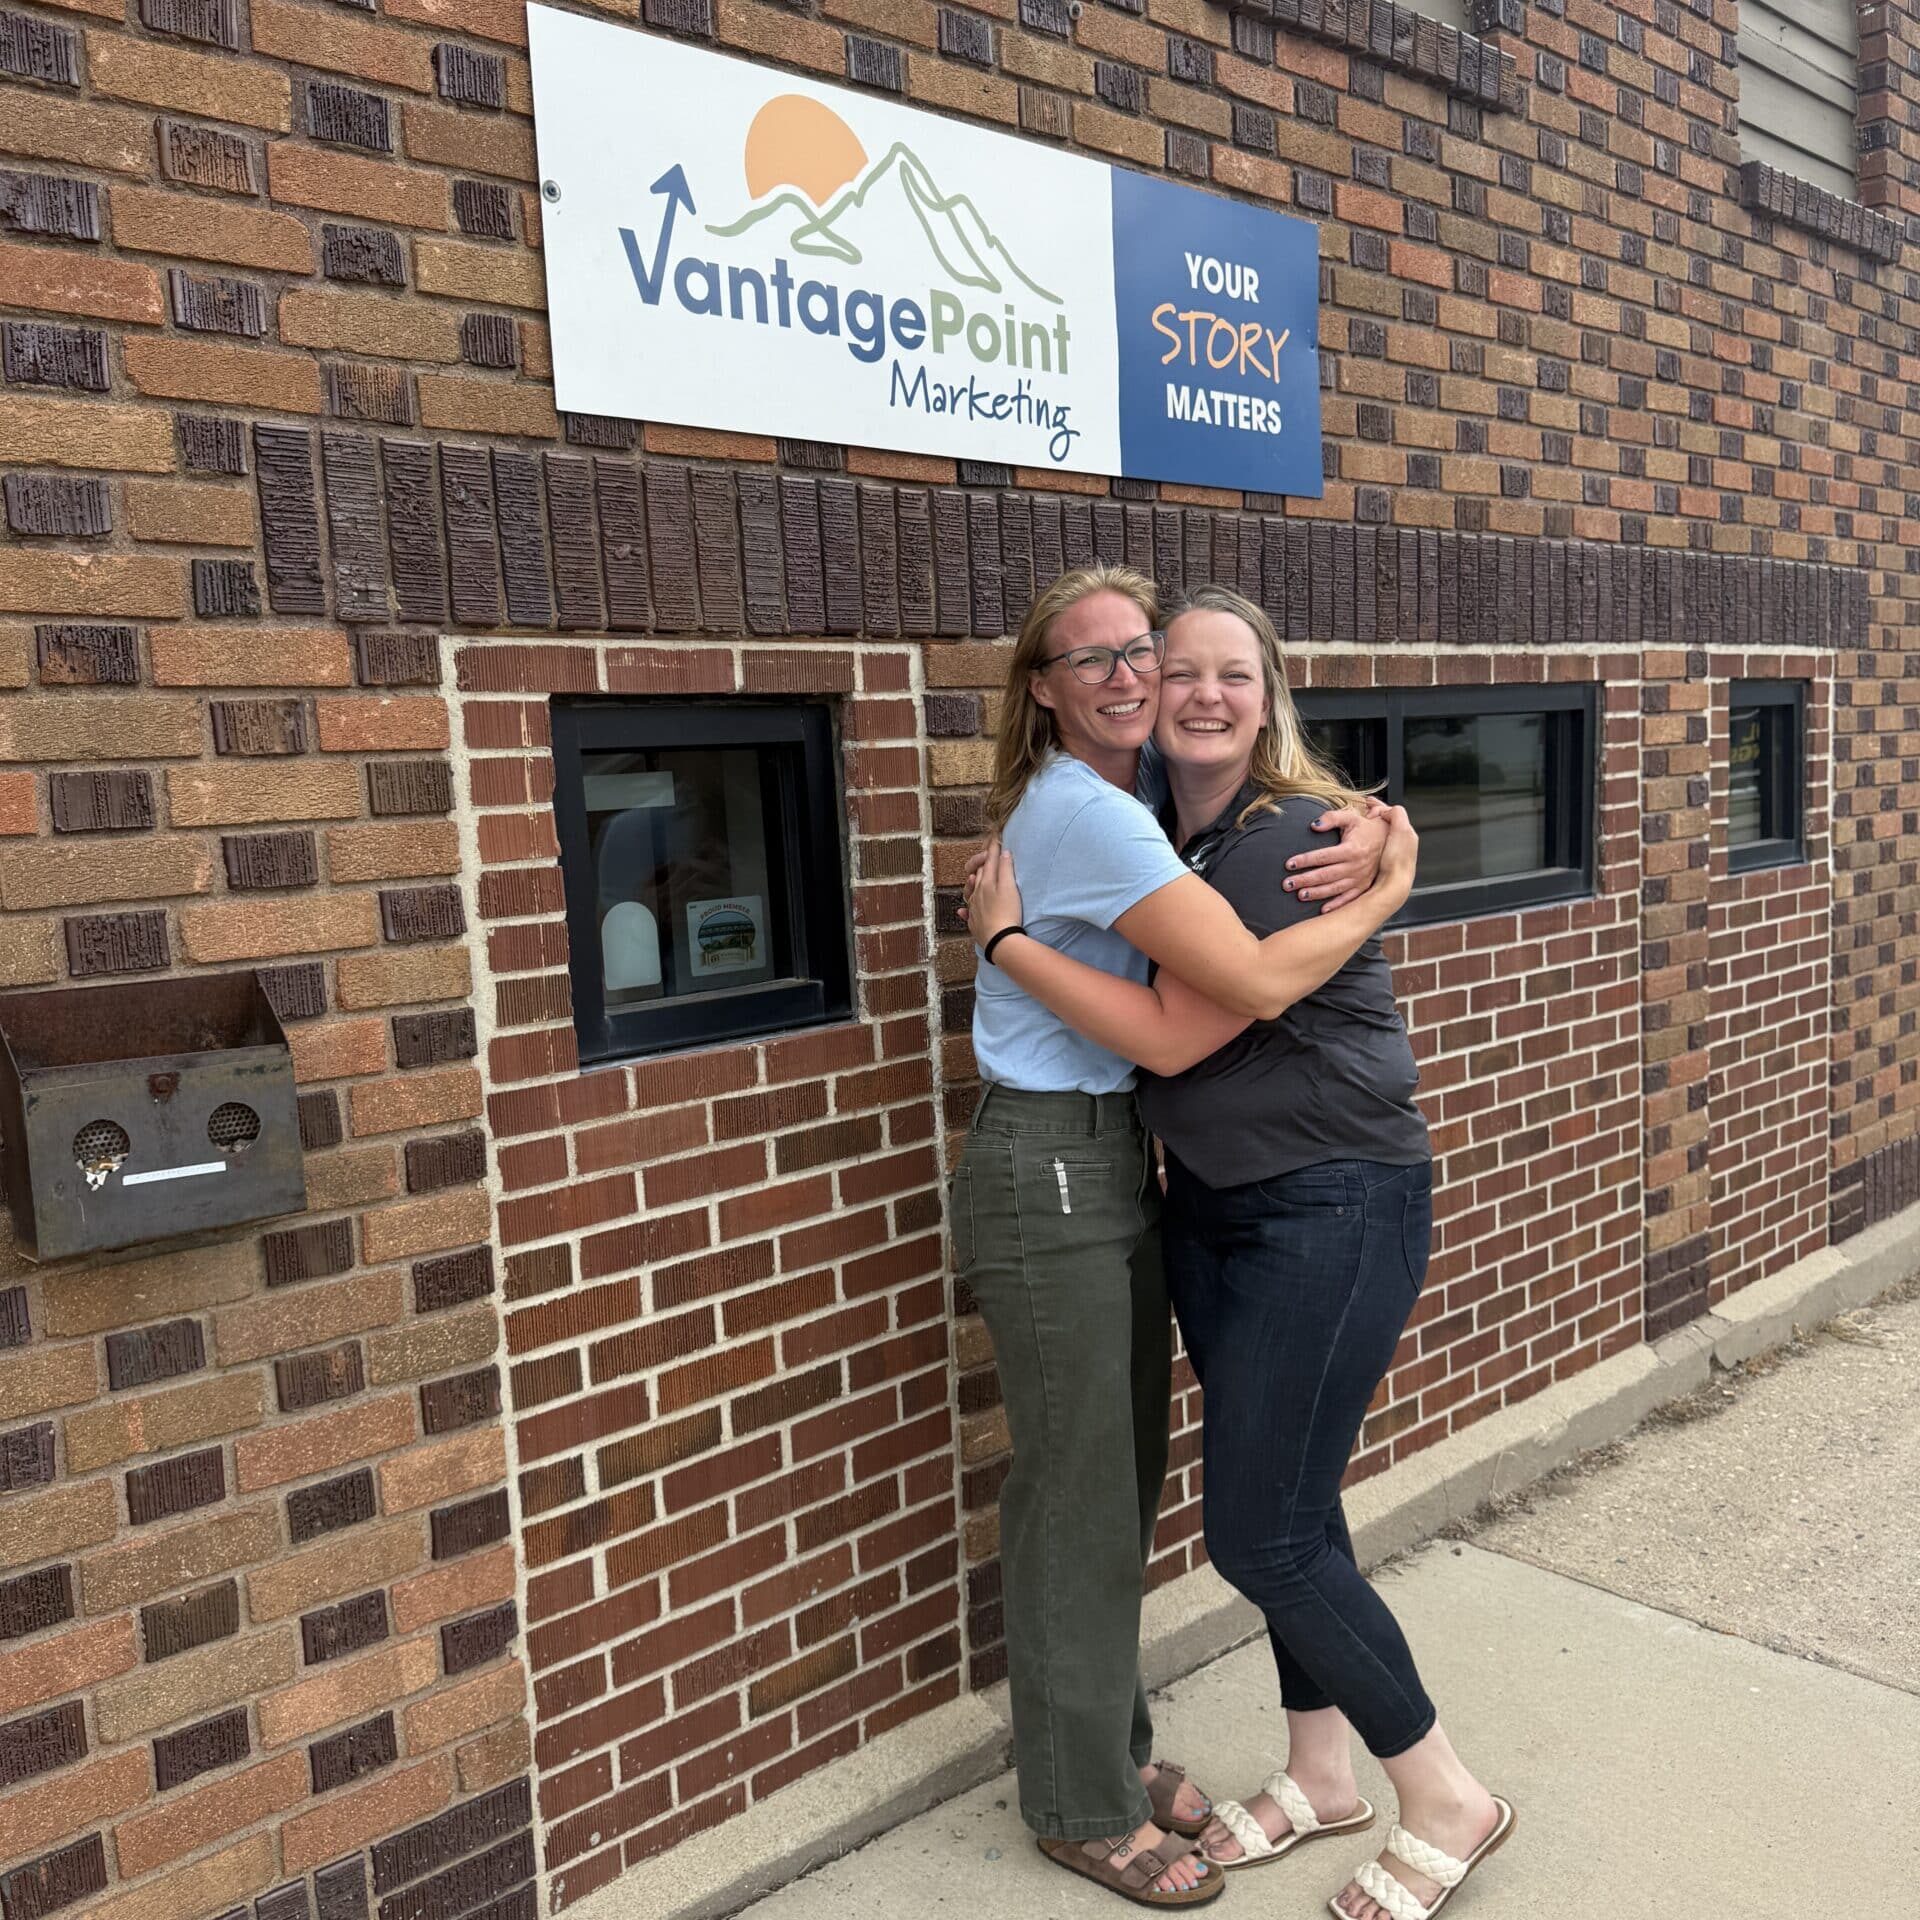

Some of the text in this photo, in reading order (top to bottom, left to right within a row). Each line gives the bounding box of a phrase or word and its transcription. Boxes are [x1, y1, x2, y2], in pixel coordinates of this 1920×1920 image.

[618, 163, 1071, 376] VantagePoint
[1184, 250, 1260, 305] YOUR
[1151, 302, 1291, 385] STORY
[889, 359, 1081, 463] Marketing
[1166, 382, 1282, 435] MATTERS
